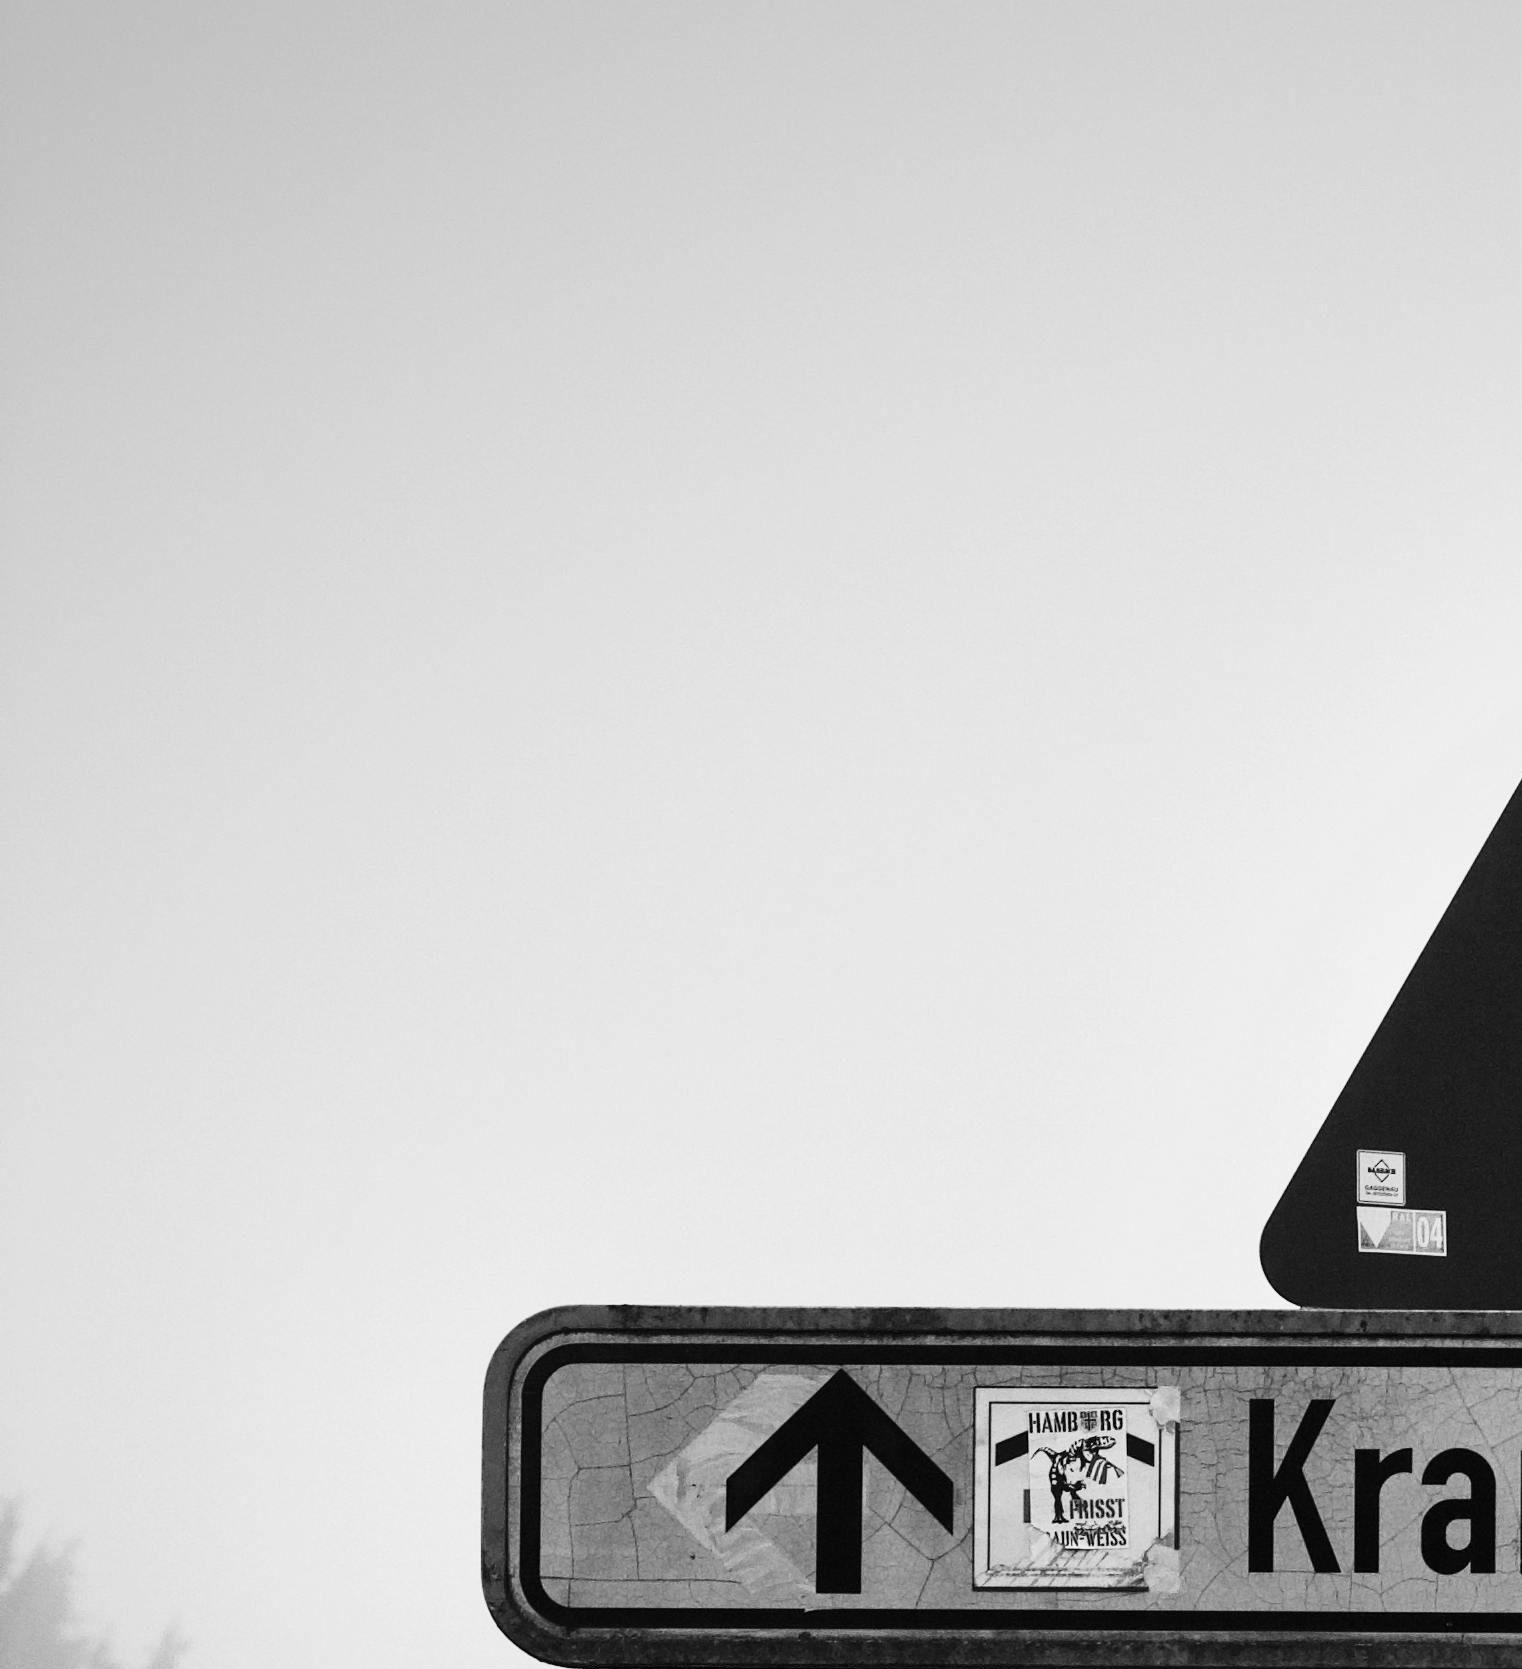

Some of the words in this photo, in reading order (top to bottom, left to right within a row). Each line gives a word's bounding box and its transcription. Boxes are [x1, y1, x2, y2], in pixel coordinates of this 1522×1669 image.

[1417, 1215, 1443, 1249] 04
[1028, 1409, 1124, 1434] HAMBRG
[1069, 1498, 1125, 1519] FRISST
